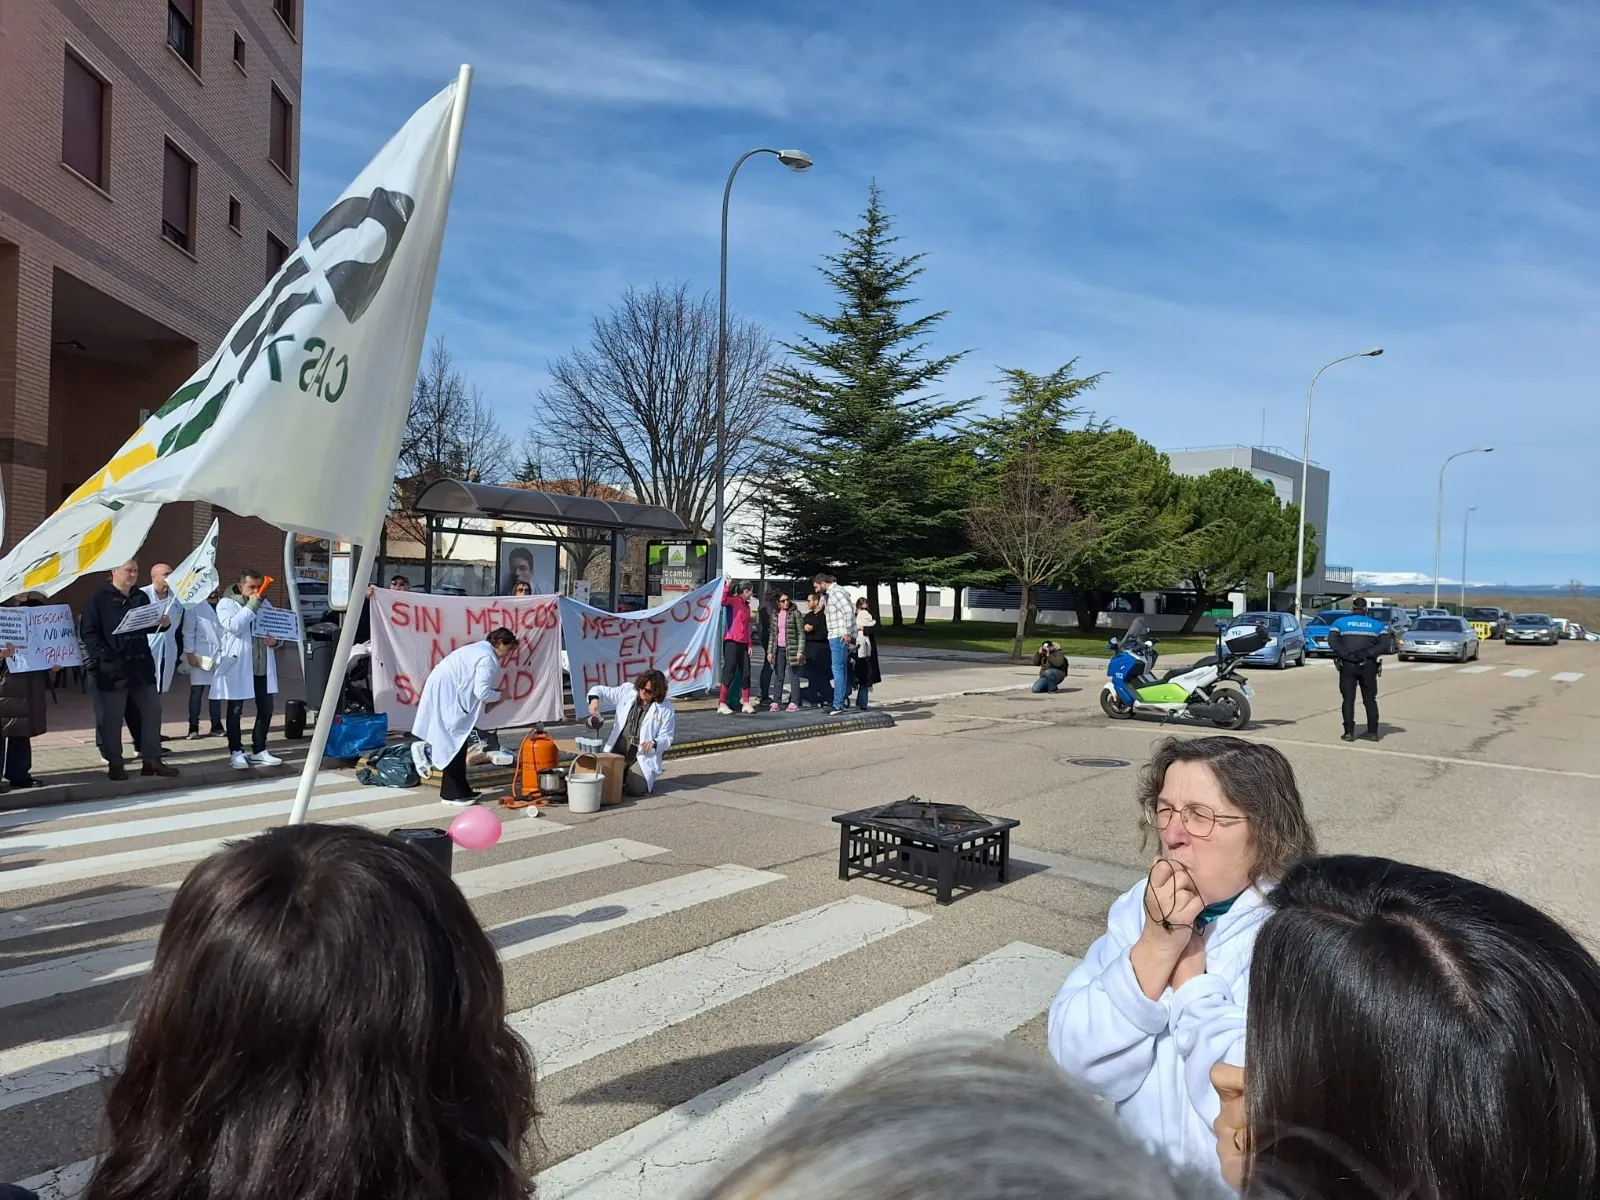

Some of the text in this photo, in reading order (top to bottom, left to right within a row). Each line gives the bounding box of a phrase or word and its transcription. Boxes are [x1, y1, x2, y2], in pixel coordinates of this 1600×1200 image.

[670, 567, 693, 578] cambio
[665, 577, 673, 585] tu
[673, 577, 692, 587] hogar
[391, 600, 558, 635] SIN MÉDICOS
[44, 627, 58, 640] NO
[619, 627, 657, 658] EN
[1115, 672, 1124, 680] 112
